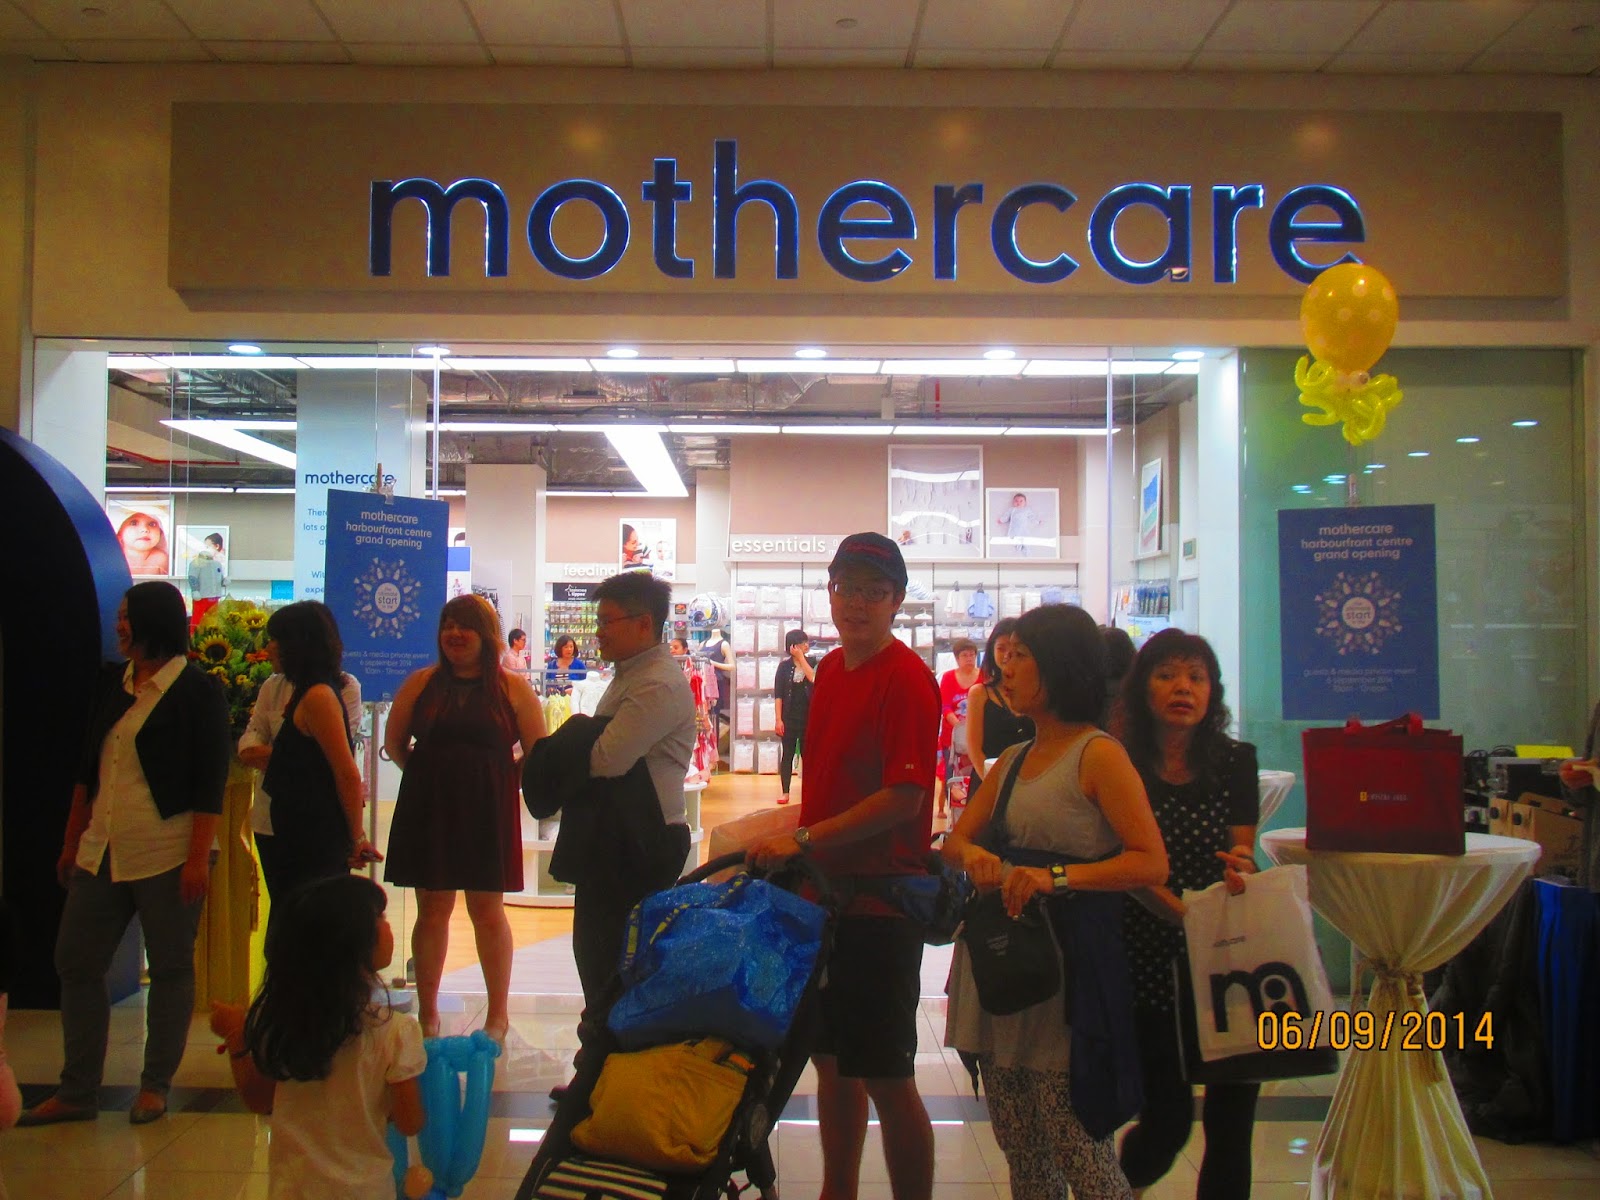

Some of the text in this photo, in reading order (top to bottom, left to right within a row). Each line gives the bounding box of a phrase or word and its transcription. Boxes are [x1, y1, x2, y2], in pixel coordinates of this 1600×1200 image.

[370, 139, 1366, 284] mothercare
[361, 510, 418, 525] mothercare
[346, 521, 433, 539] harbourfront centre
[1319, 523, 1394, 536] mothercare
[355, 534, 422, 550] grand opening
[731, 536, 826, 554] essentials
[1301, 537, 1414, 549] harbourfront centre
[1313, 548, 1401, 562] grand opening
[377, 595, 398, 605] start
[1346, 611, 1371, 620] start
